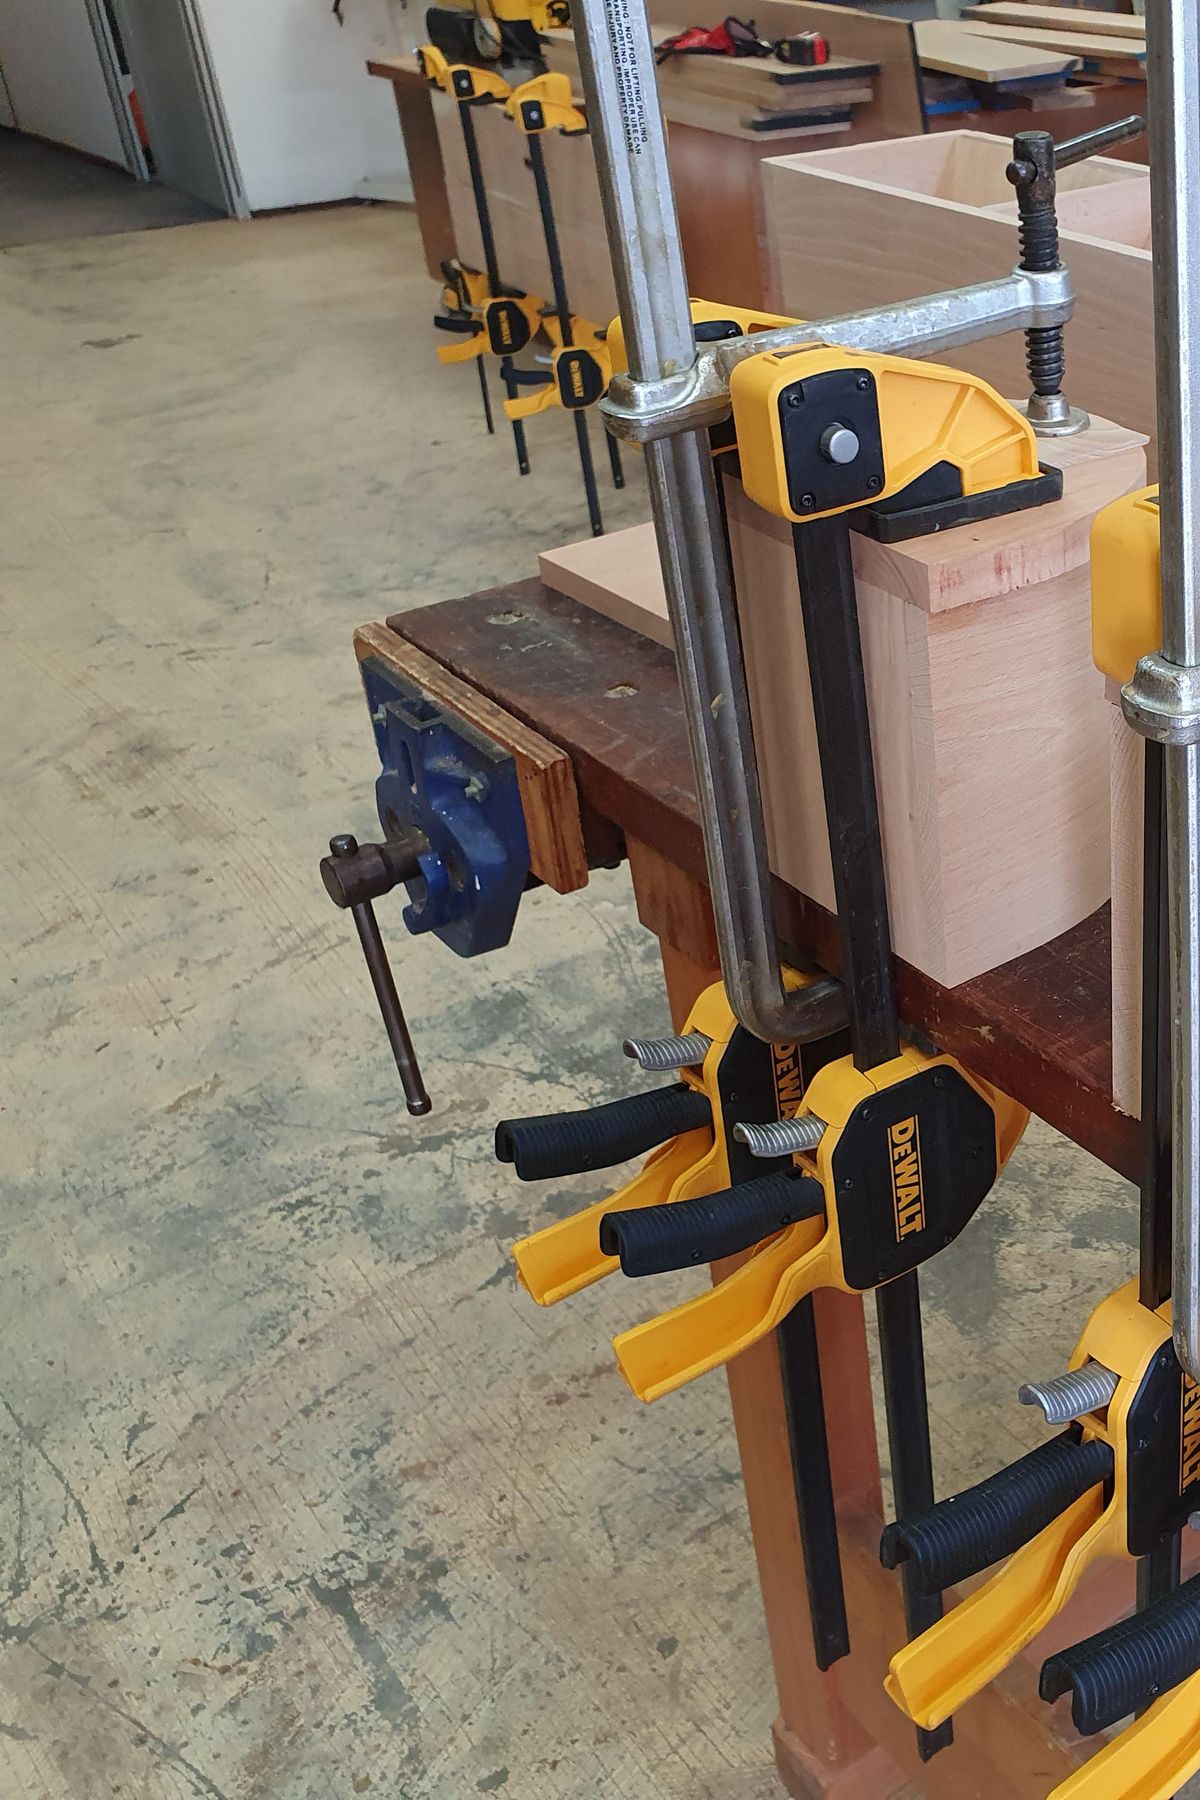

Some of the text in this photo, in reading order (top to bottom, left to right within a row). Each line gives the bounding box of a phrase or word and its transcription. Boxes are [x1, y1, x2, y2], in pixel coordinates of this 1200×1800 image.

[607, 10, 617, 42] INJURY
[612, 46, 620, 64] AND
[616, 66, 628, 114] PROPERTY
[624, 26, 634, 44] NOT
[628, 48, 636, 65] FOR
[623, 68, 636, 115] IMPROPER
[630, 118, 638, 134] USE
[634, 136, 642, 154] CAN
[772, 1044, 801, 1120] DEWA
[891, 1116, 923, 1236] DEWALT
